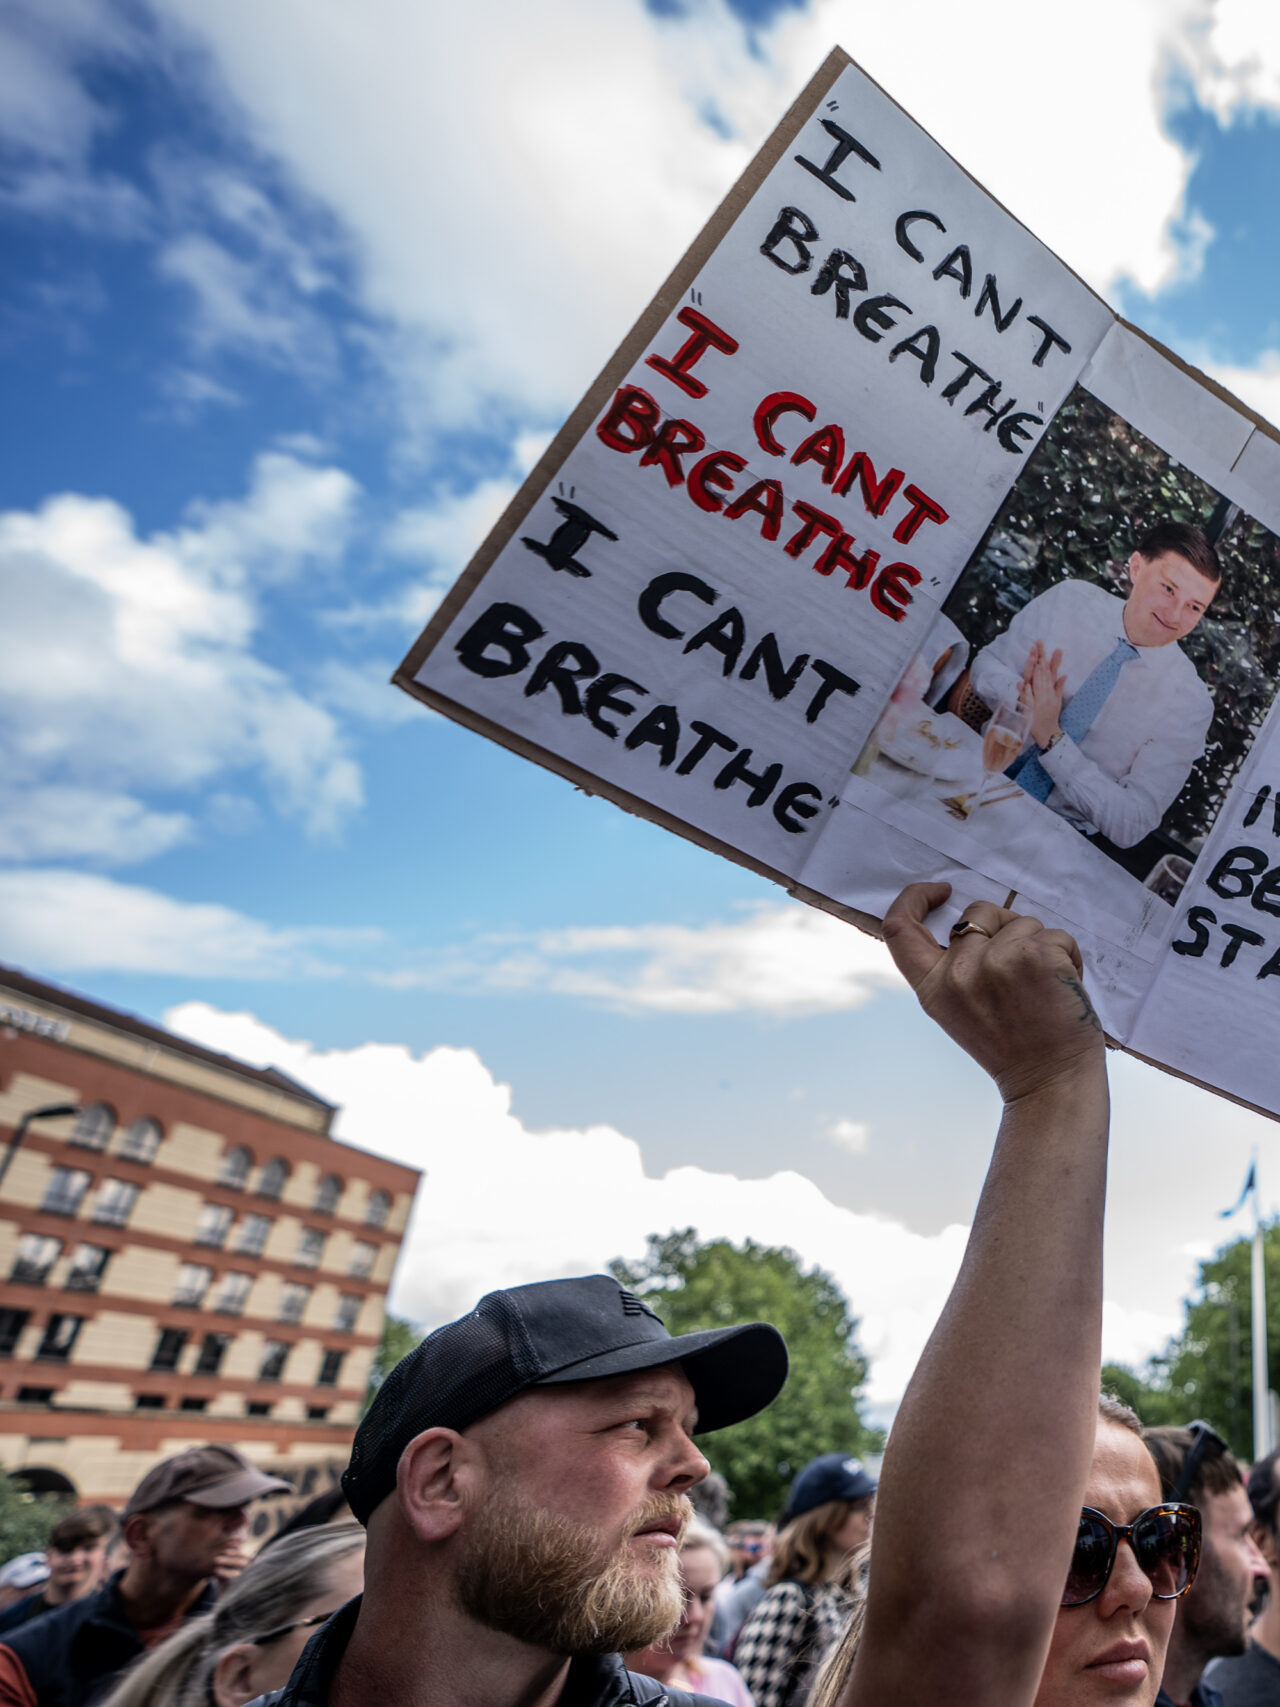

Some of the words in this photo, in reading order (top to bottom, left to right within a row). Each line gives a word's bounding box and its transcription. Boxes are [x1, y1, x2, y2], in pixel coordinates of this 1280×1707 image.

[894, 209, 1073, 368] CANT
[752, 390, 950, 545] CANT
[637, 571, 862, 725] CANT
